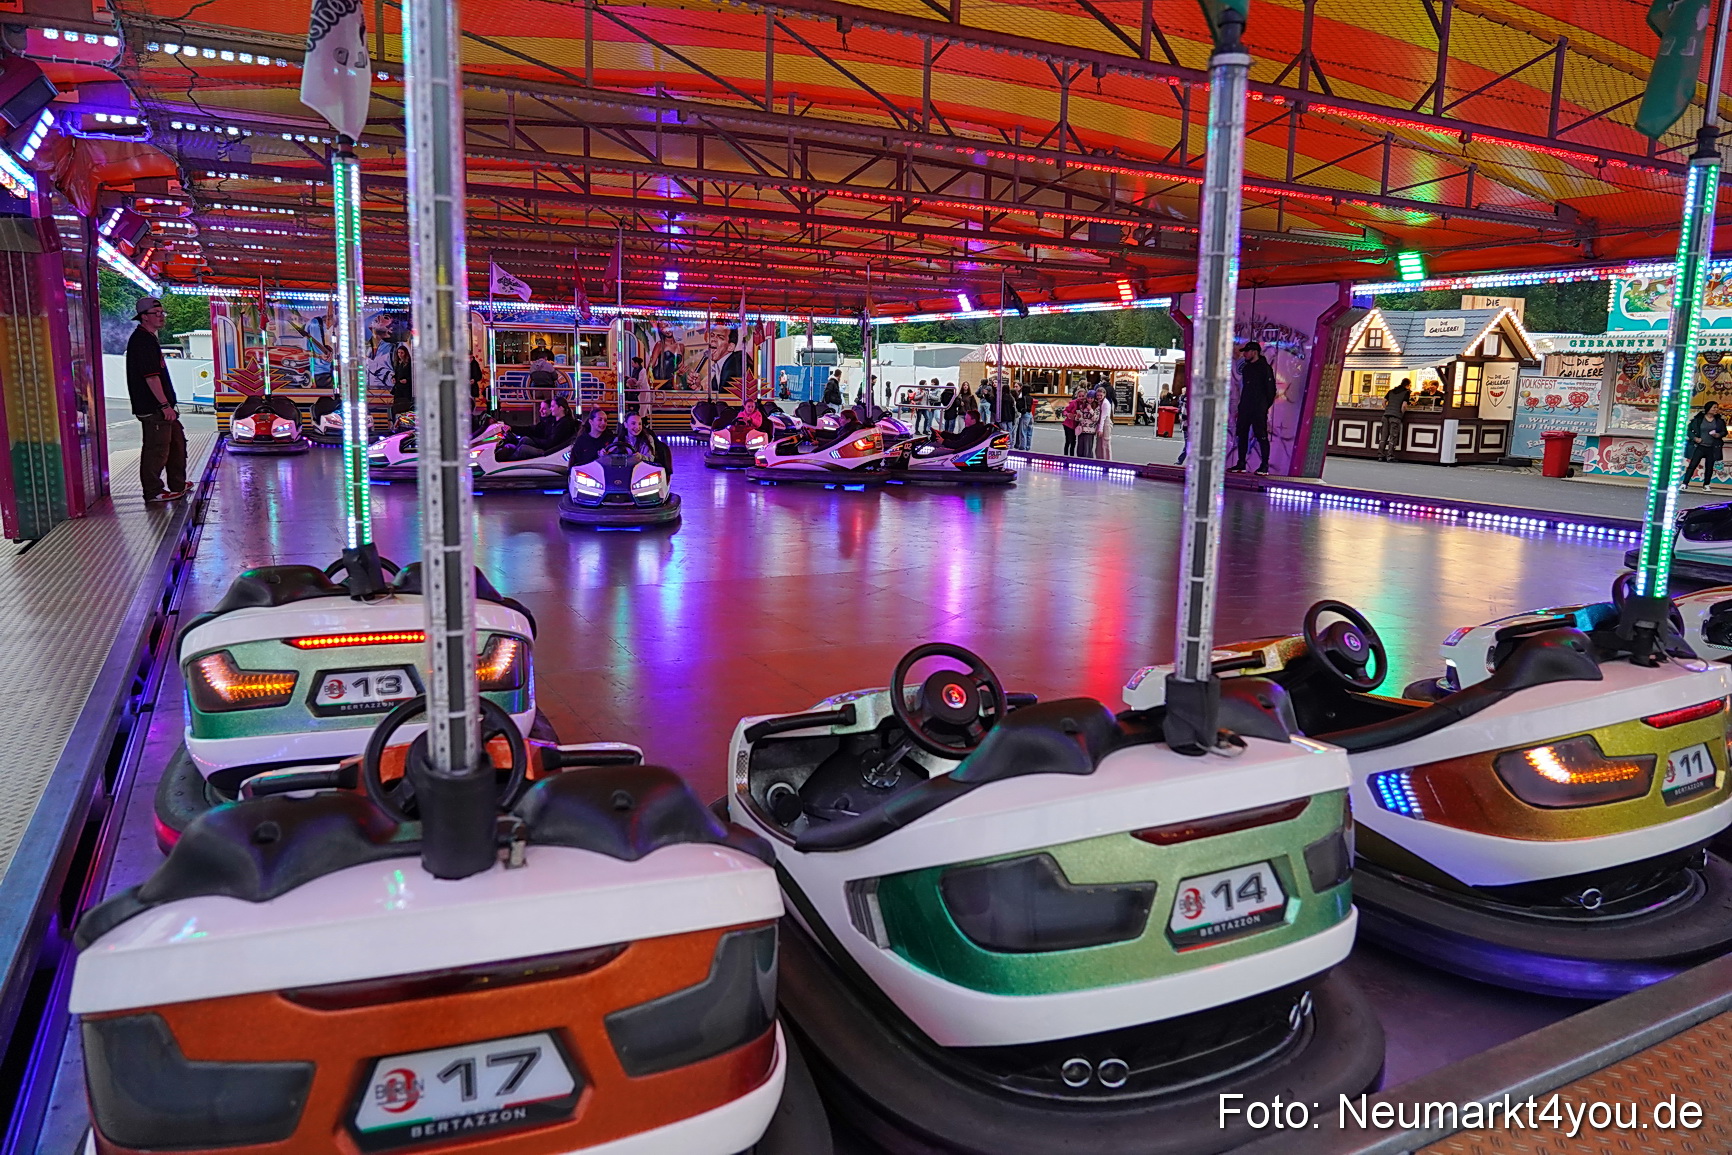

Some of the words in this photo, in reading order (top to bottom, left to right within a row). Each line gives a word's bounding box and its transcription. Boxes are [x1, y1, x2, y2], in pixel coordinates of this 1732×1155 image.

[1486, 298, 1500, 307] DIE
[1429, 326, 1459, 334] GRILLEREI
[1569, 338, 1654, 348] GEBRANNTE
[1577, 358, 1589, 366] DIE
[1521, 378, 1557, 390] VOLKSFEST
[1539, 423, 1569, 432] Ihren
[1551, 418, 1586, 427] freuen
[352, 675, 403, 697] 13
[340, 701, 395, 711] BERTAZZON
[1679, 750, 1704, 777] 11
[1674, 782, 1704, 796] BERTAZZON
[1211, 872, 1267, 911] 14
[1200, 915, 1261, 937] BERTAZZON
[437, 1046, 542, 1102] 17
[411, 1107, 527, 1138] BERTAZZON
